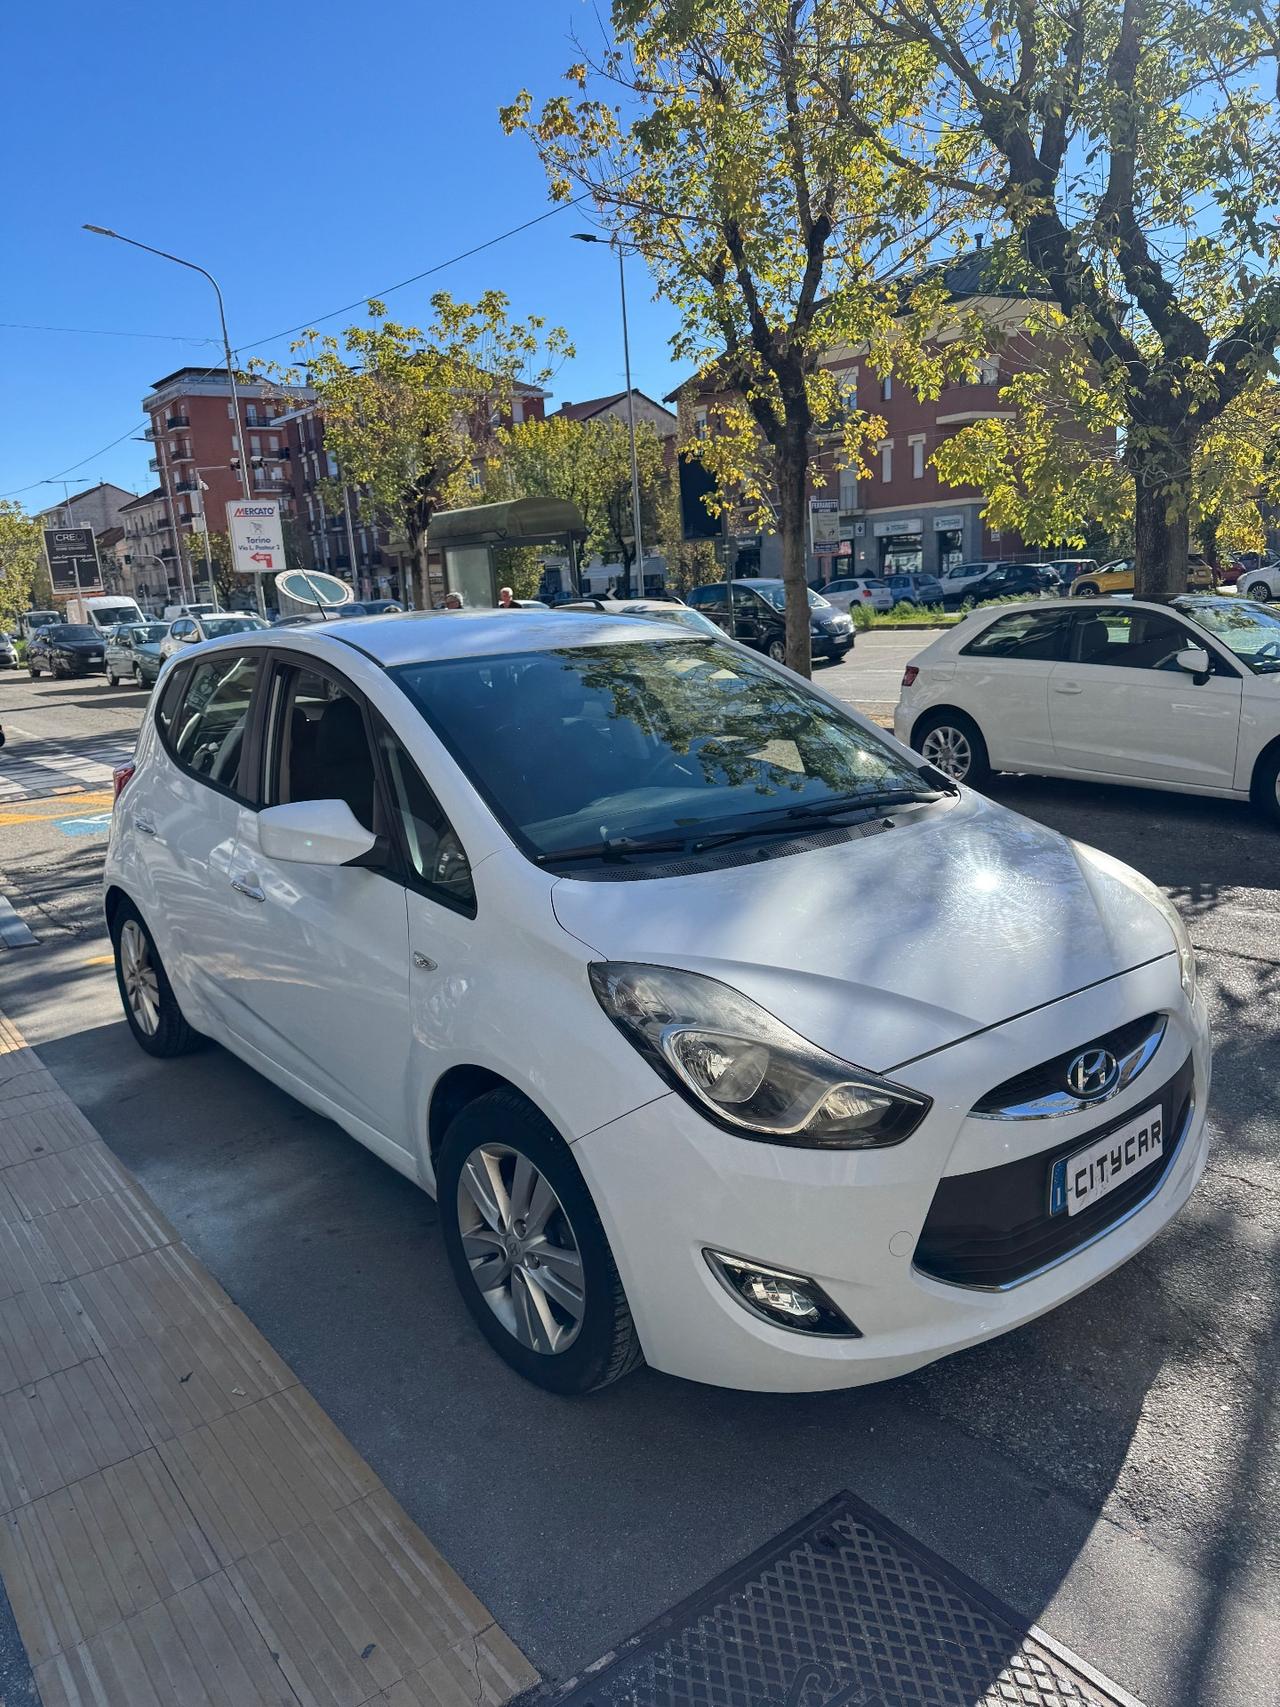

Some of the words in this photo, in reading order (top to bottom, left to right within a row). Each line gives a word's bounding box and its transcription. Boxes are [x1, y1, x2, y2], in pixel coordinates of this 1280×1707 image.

[234, 508, 274, 517] MERCATO
[246, 536, 271, 544] Torino
[1075, 1120, 1161, 1199] CITYCAR
